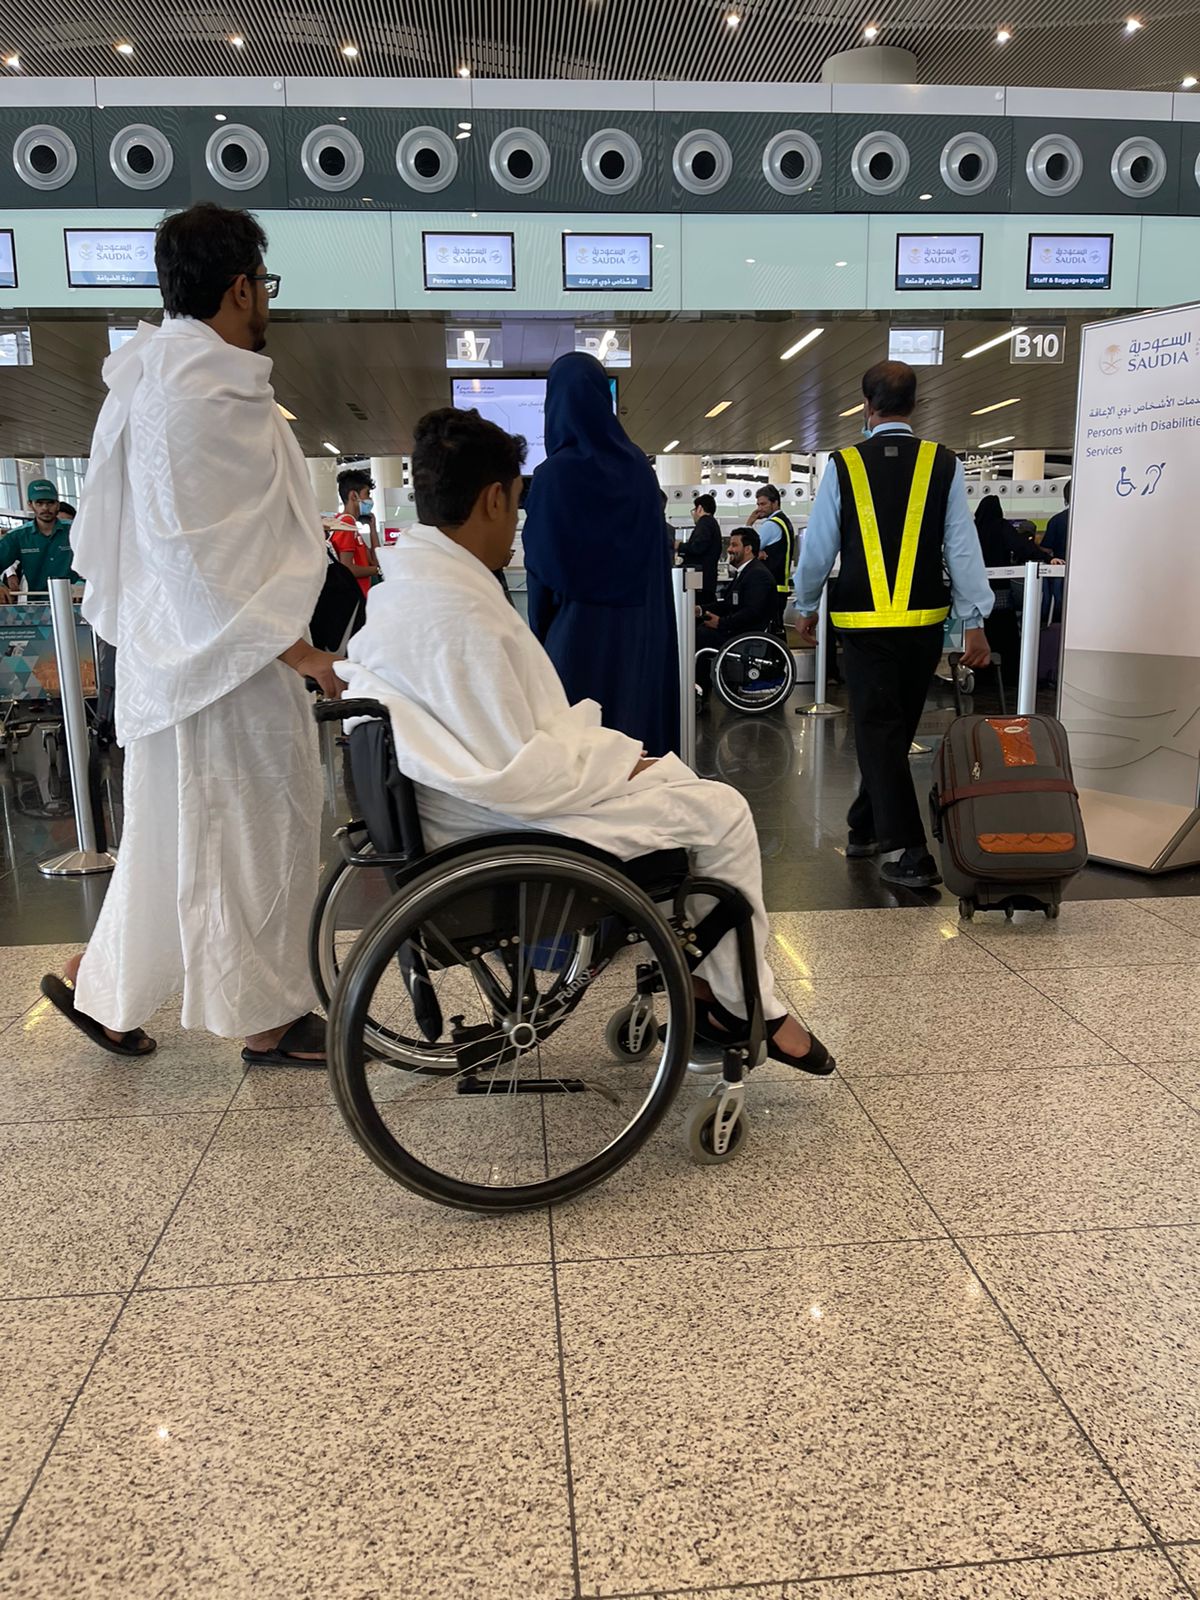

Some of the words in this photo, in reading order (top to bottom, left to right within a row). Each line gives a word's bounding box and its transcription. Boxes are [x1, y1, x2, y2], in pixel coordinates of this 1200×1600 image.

[96, 252, 133, 261] SAUDIA
[452, 256, 488, 264] SAUDIA
[591, 256, 626, 265] SAUDIA
[924, 256, 957, 264] SAUDIA
[1055, 256, 1088, 264] SAUDIA
[432, 277, 457, 285] Persons
[457, 277, 472, 285] with
[472, 277, 508, 285] Disabilities
[1054, 277, 1080, 285] Baggage
[456, 337, 491, 361] B7
[1014, 333, 1059, 358] B10
[1128, 331, 1192, 357] السعودية
[1127, 350, 1190, 372] SAUDIA
[1117, 404, 1132, 419] ذوي
[1087, 426, 1123, 439] Persons
[1125, 422, 1148, 434] with
[1150, 415, 1200, 432] Disabilitie
[1086, 445, 1123, 458] Services
